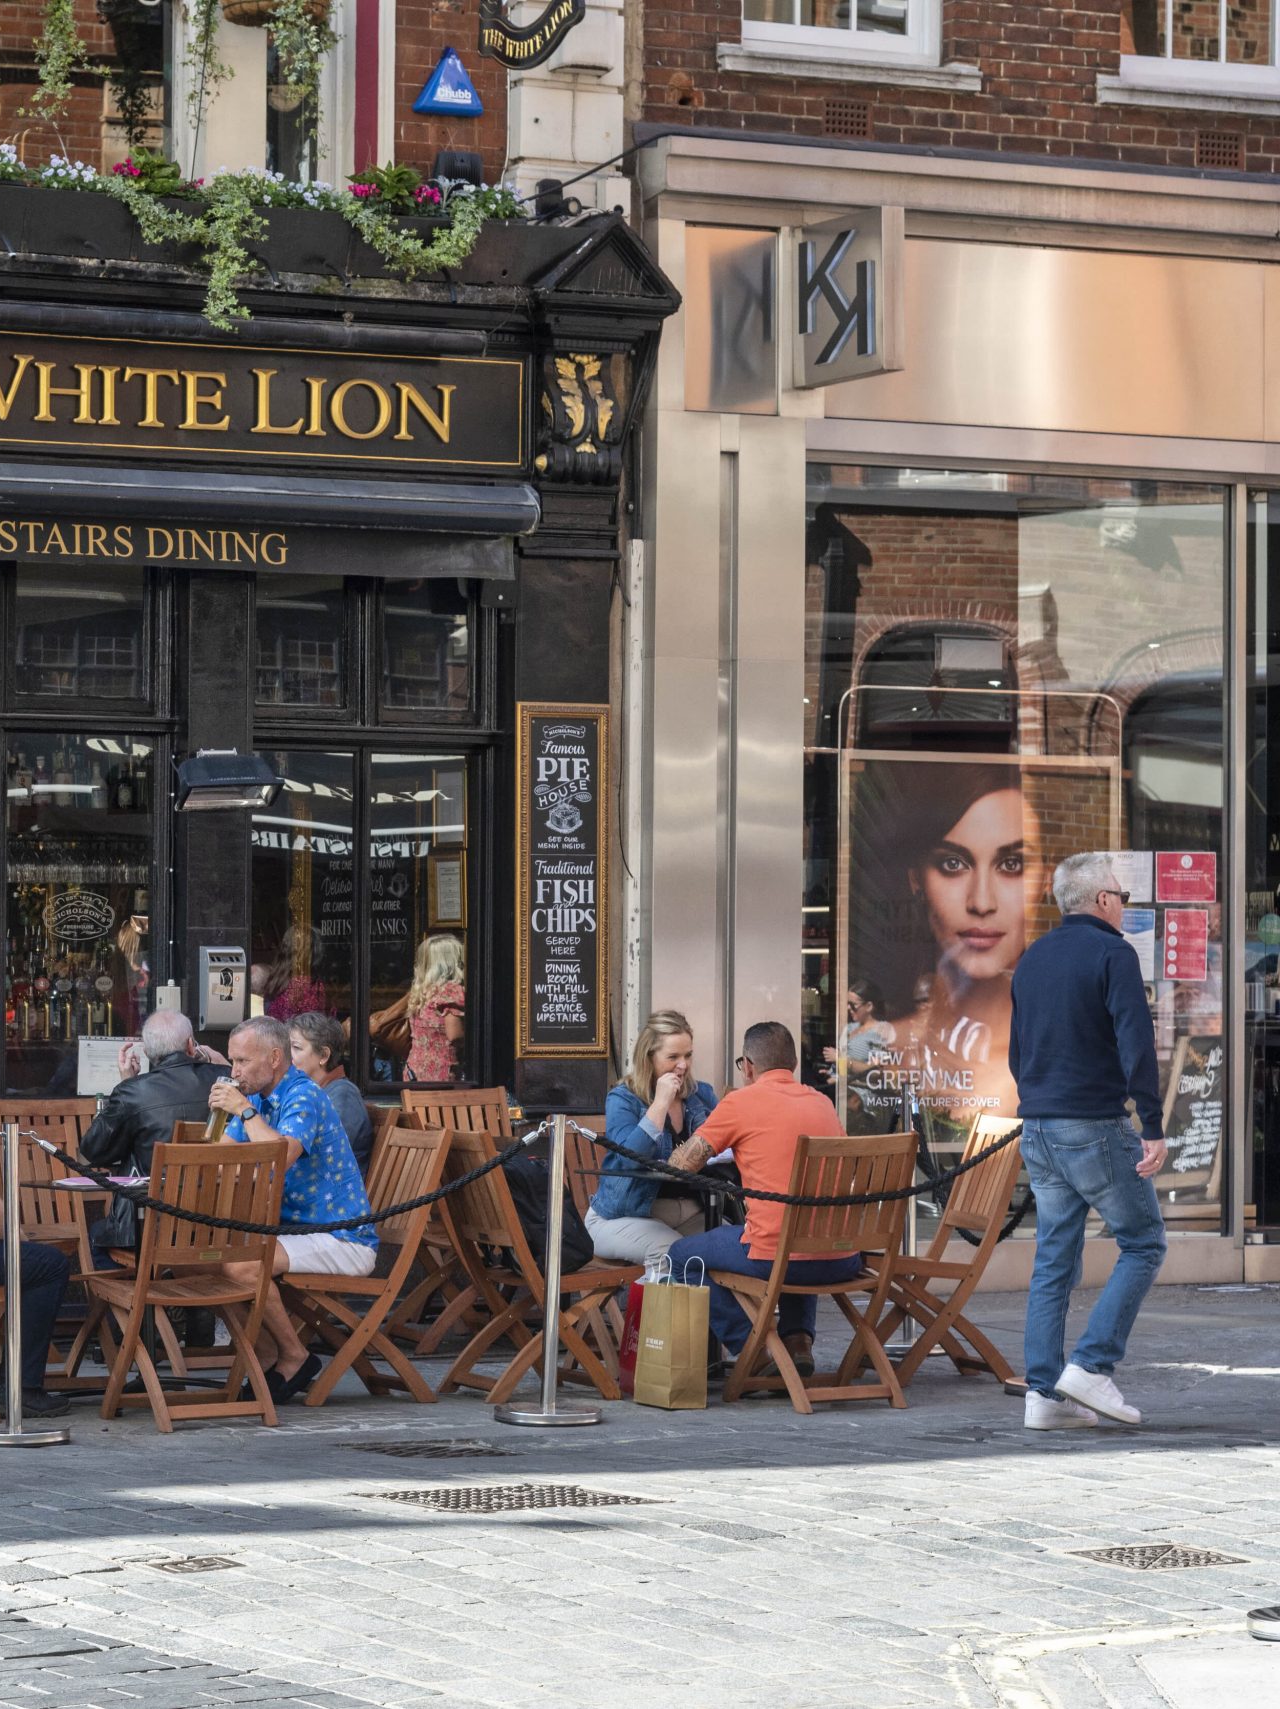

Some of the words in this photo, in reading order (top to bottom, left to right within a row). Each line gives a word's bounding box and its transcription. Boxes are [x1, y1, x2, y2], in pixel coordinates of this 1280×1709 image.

[483, 29, 504, 51] THE
[505, 31, 544, 59] WHITE
[544, 1, 574, 41] LION
[436, 87, 472, 100] Chubb
[250, 368, 457, 443] LION
[145, 527, 289, 566] DINING
[541, 740, 585, 754] Famous
[536, 757, 590, 782] PIE
[538, 780, 588, 807] HOUSE
[534, 860, 595, 876] Traditional
[535, 879, 595, 904] FISH
[321, 919, 353, 936] BRITIS
[531, 908, 596, 933] CHIPS
[545, 936, 581, 945] SERVED
[550, 946, 576, 956] HERE
[545, 963, 581, 973] DINING
[547, 974, 577, 983] ROOM
[535, 984, 560, 994] WITH
[564, 984, 589, 994] FULL
[547, 993, 577, 1003] TABLE
[542, 1003, 583, 1012] SERVICE
[536, 1012, 588, 1023] UPSTAIRS
[867, 1051, 904, 1066] NEW
[865, 1070, 937, 1090] GREEN
[942, 1070, 974, 1090] ME
[916, 1097, 960, 1107] ATURE'S
[962, 1097, 1001, 1107] POWER
